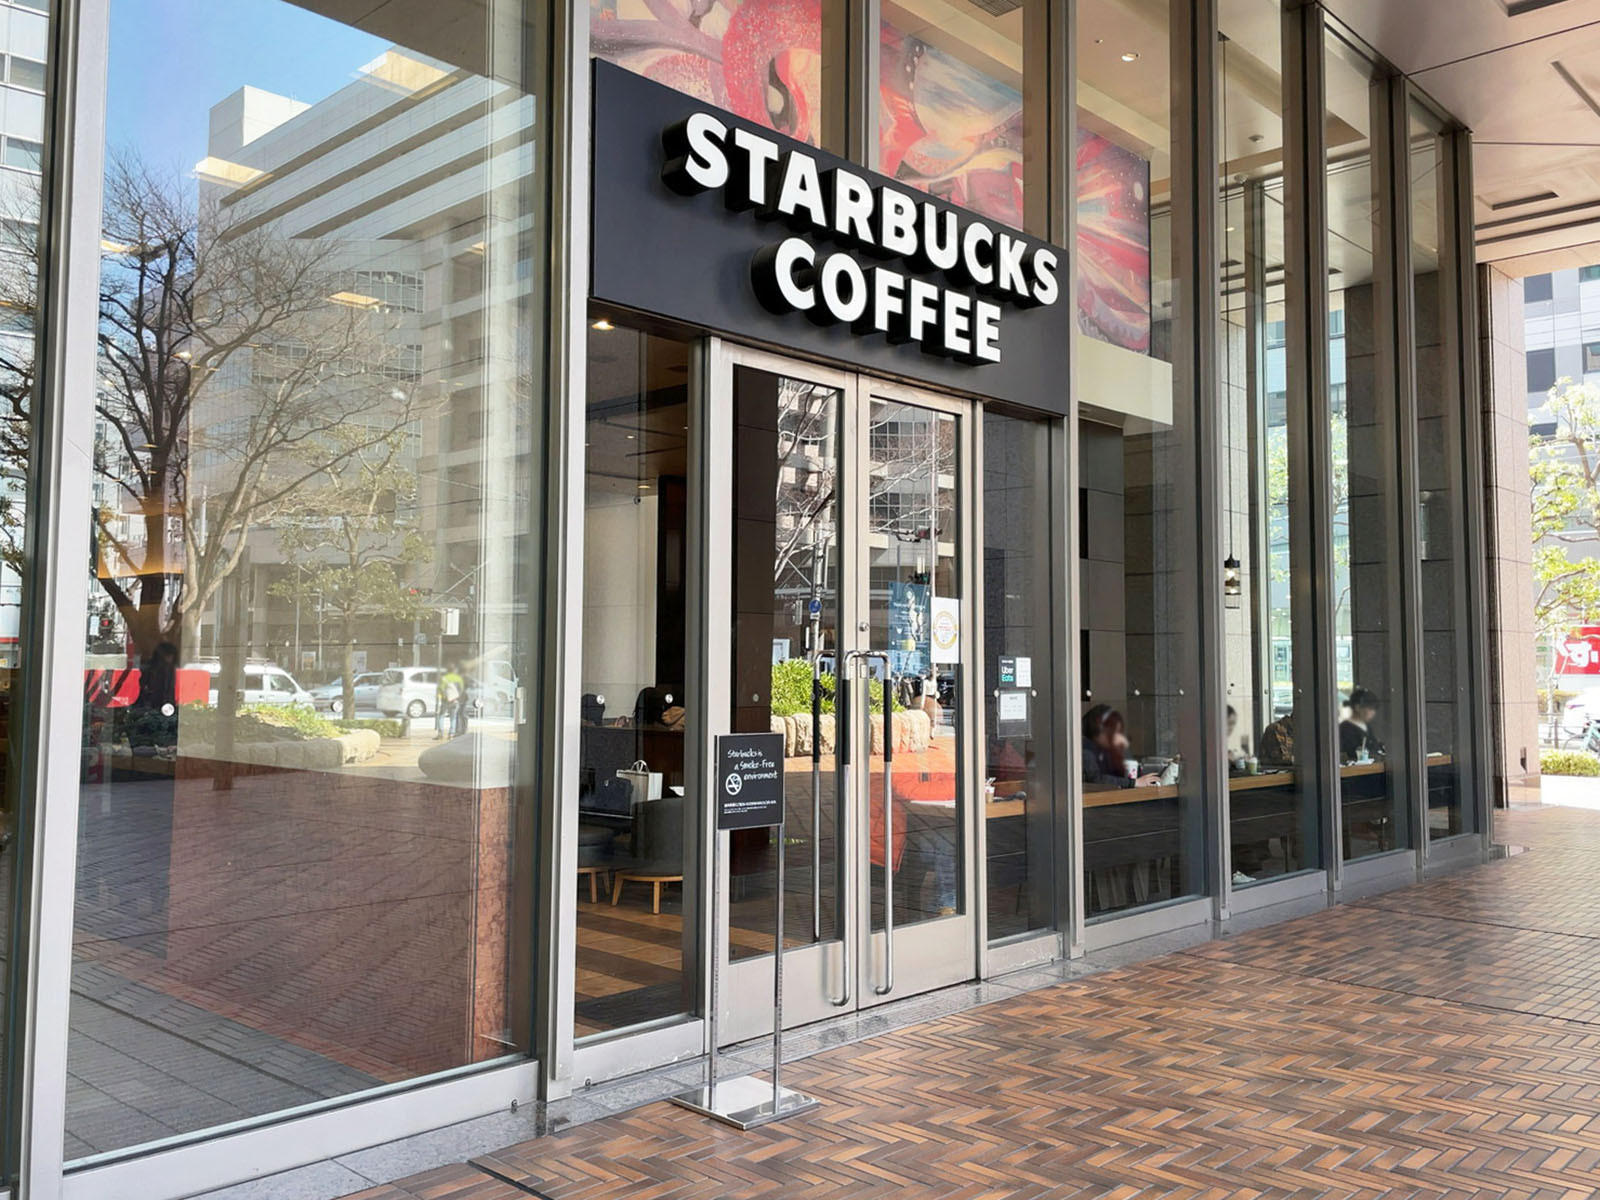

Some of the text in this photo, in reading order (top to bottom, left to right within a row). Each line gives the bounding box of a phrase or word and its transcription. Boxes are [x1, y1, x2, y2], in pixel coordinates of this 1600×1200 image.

[685, 112, 1059, 306] STARBUCKS
[775, 237, 1001, 363] COFFEE
[1001, 666, 1014, 674] Uber
